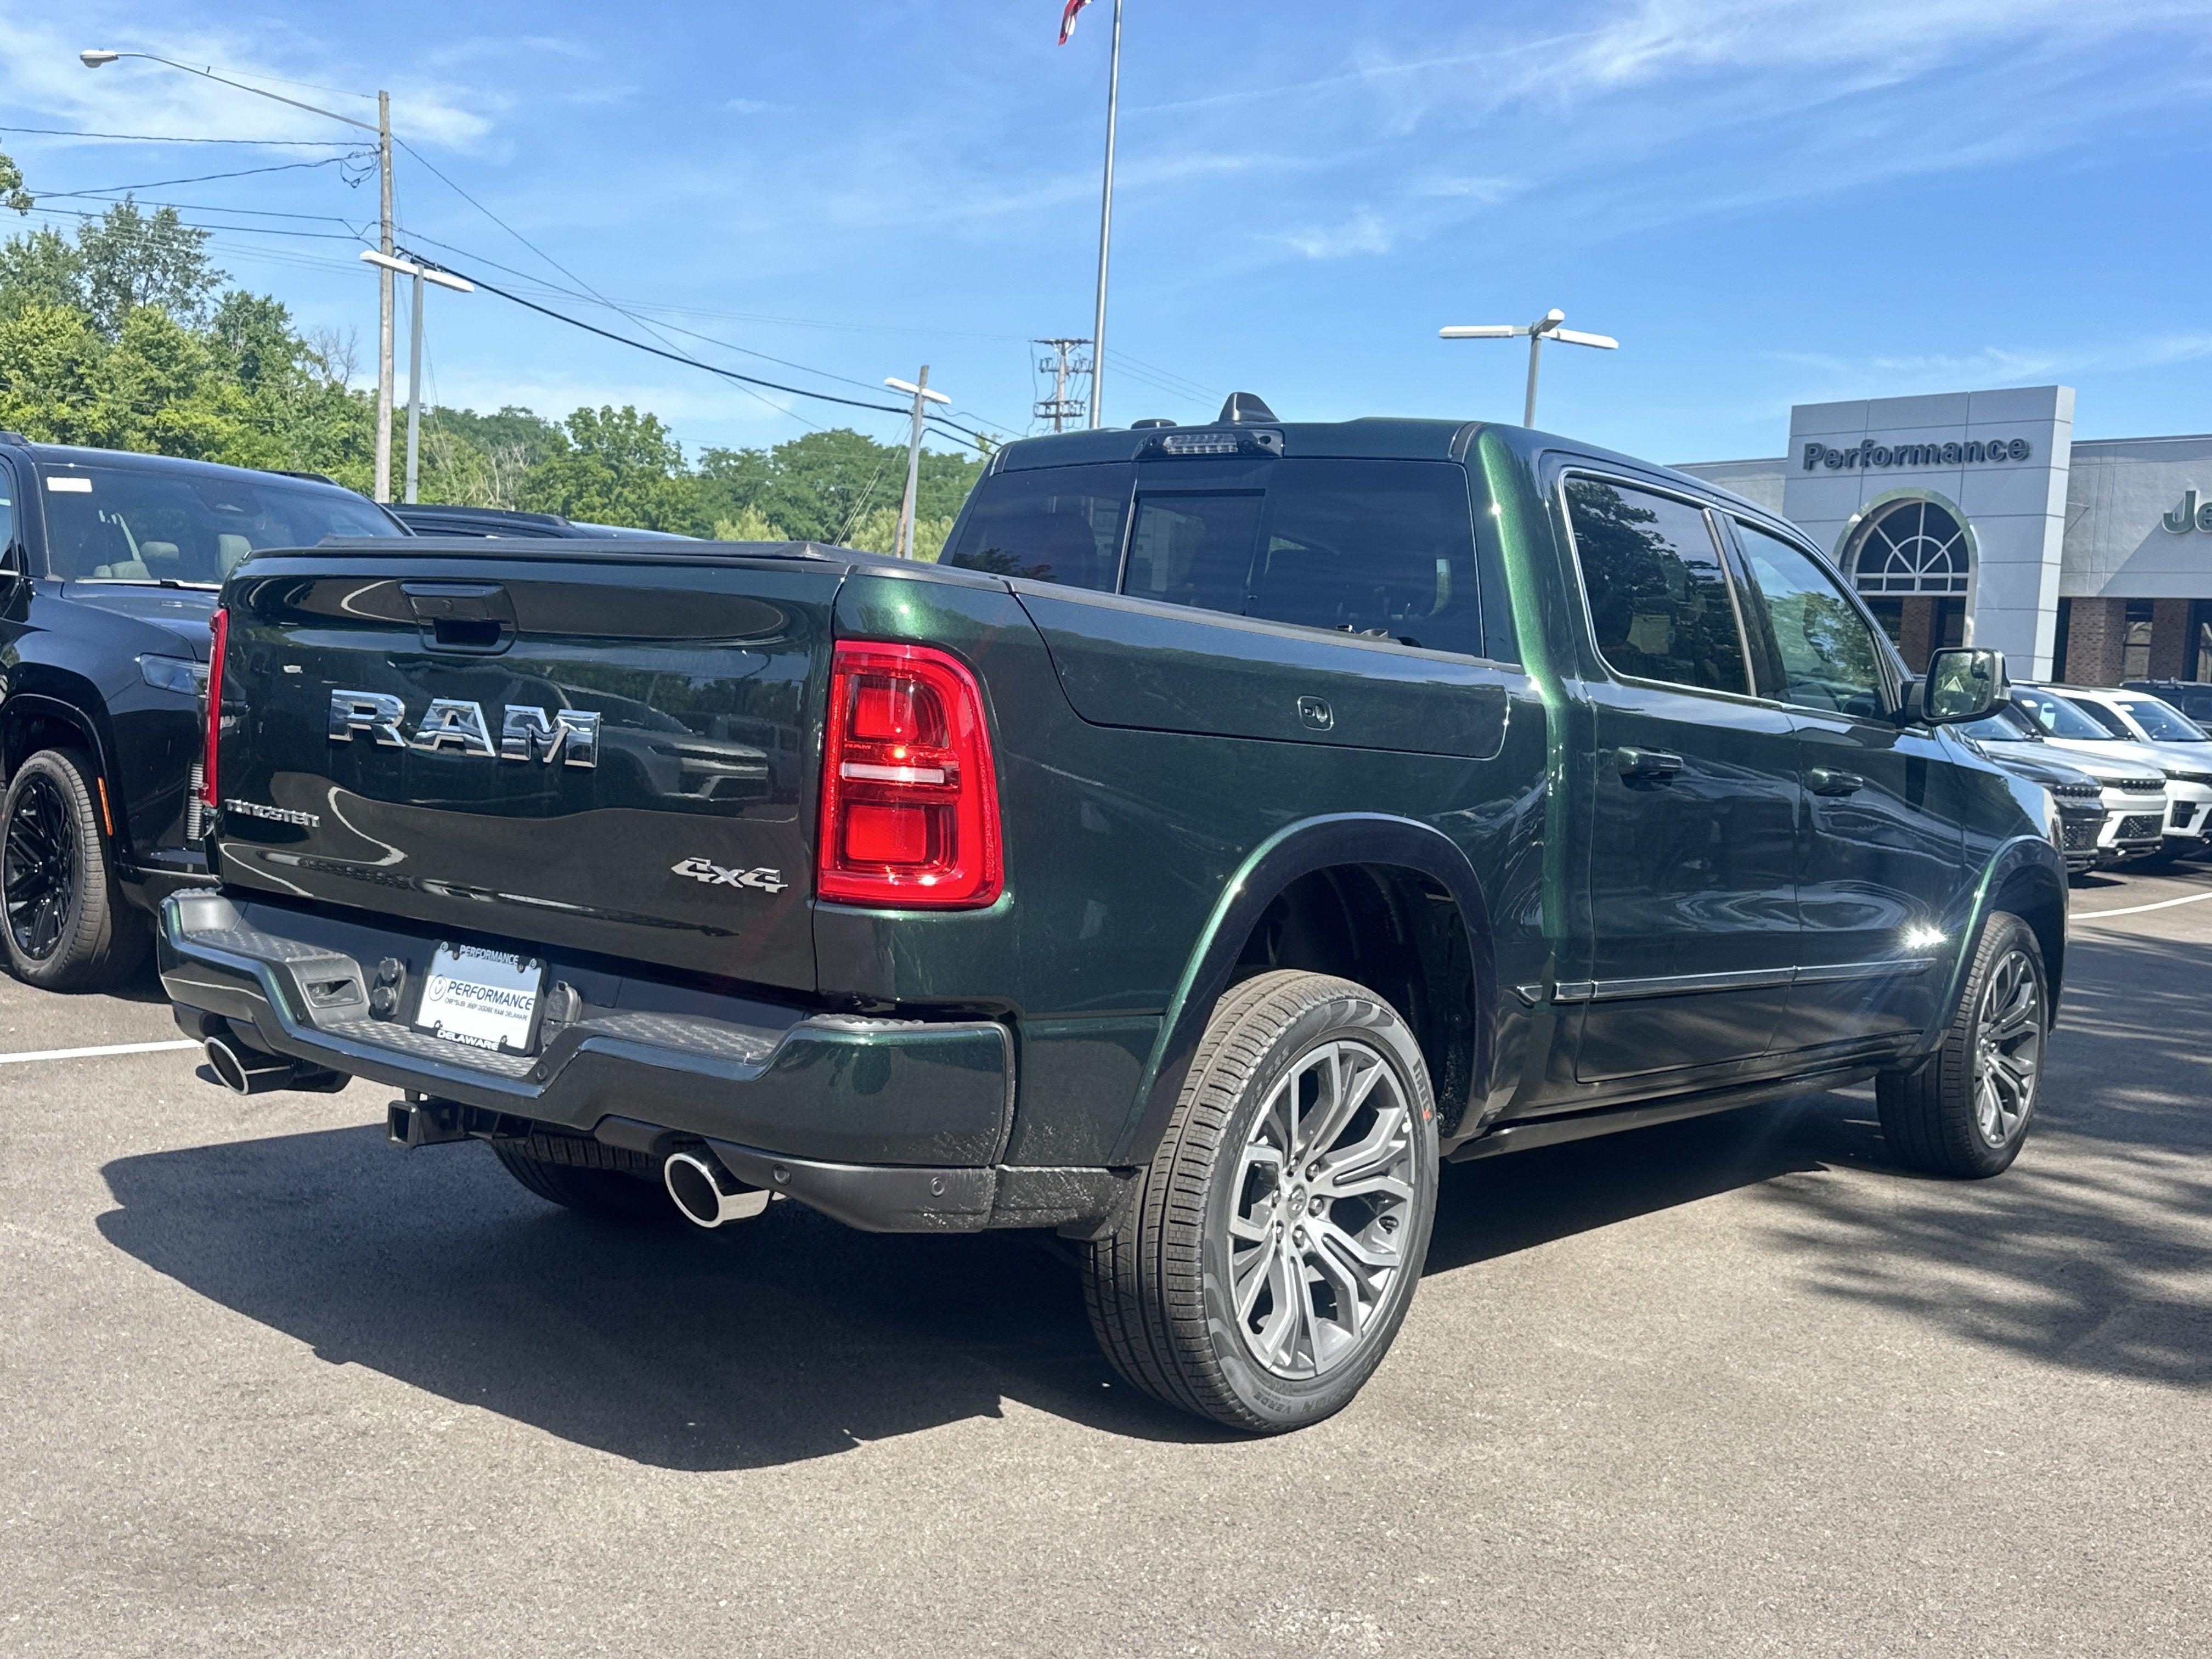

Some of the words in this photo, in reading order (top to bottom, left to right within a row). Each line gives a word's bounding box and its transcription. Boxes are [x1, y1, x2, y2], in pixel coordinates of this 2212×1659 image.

[1803, 438, 2031, 470] Performance
[329, 689, 601, 768] RAM
[224, 799, 320, 828] TUNGSTEN
[459, 945, 519, 966] PERFORMANCE
[447, 980, 535, 1011] PERFORMANCE
[437, 1029, 499, 1051] DELAWARE
